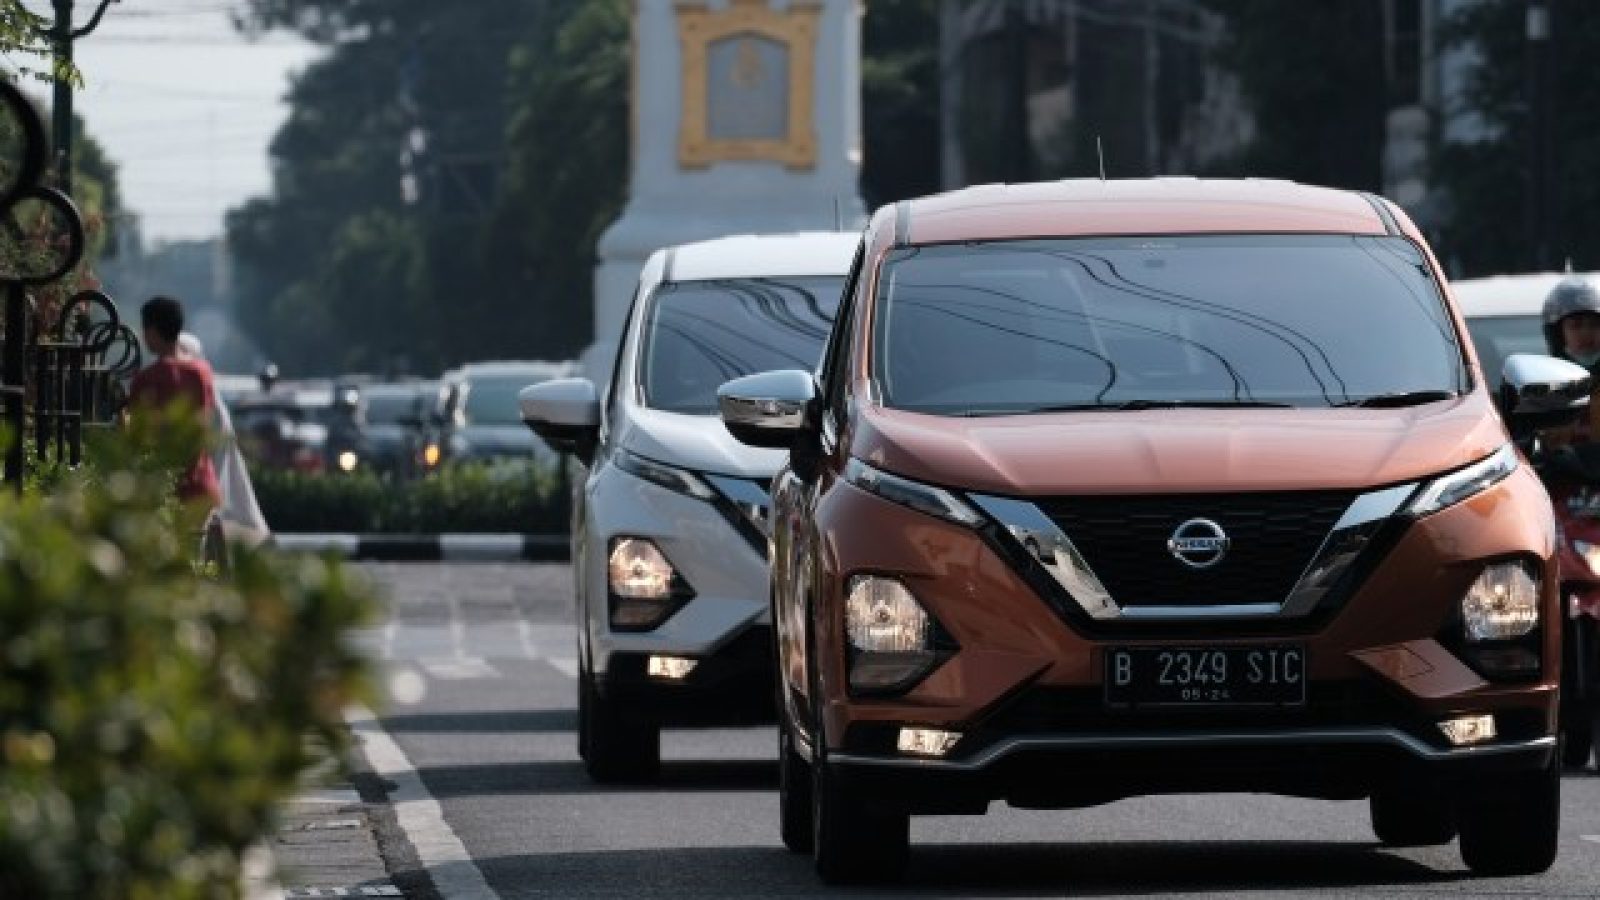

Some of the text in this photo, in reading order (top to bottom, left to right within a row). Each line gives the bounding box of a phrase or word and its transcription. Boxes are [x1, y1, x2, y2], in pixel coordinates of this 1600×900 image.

[1115, 651, 1300, 685] B 2349 SIC
